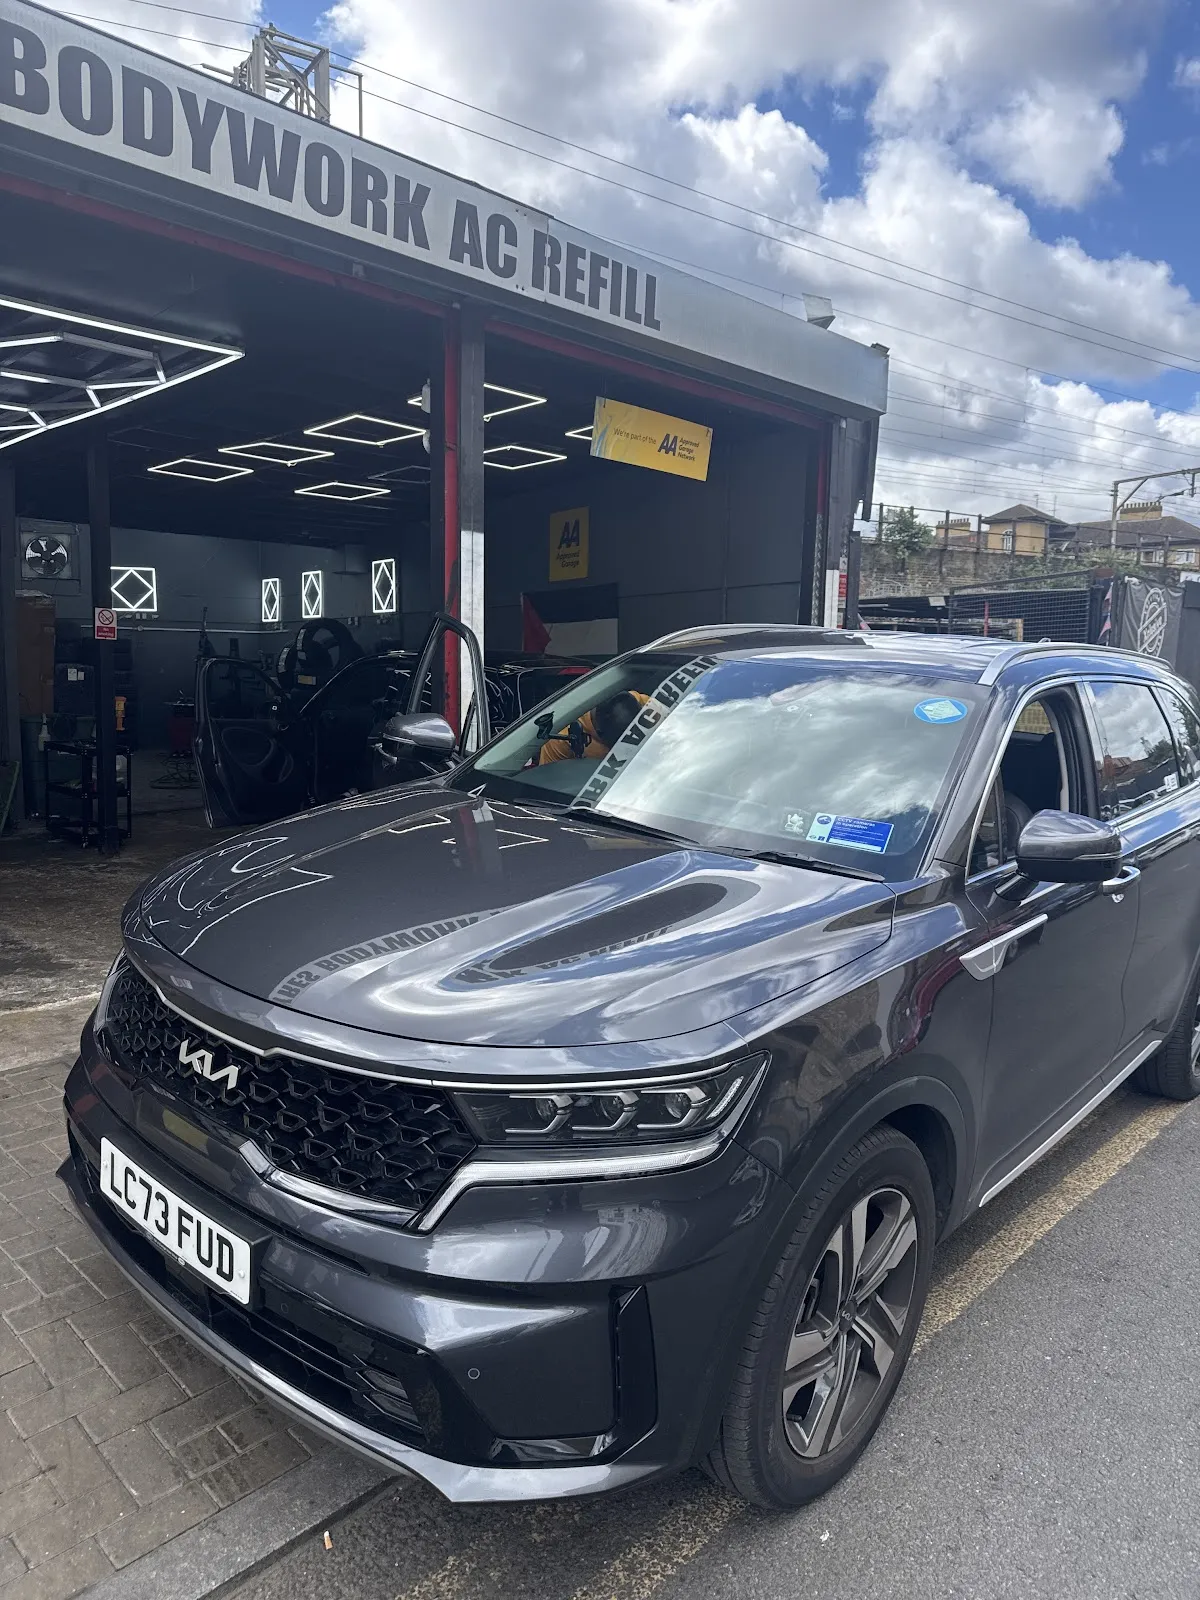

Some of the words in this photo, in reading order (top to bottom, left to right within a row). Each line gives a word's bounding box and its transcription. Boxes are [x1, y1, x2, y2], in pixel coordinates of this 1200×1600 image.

[0, 18, 430, 250] BODYWORK
[449, 200, 518, 279] AC
[532, 229, 661, 331] REFILL
[614, 428, 630, 439] We're
[631, 433, 641, 441] part
[648, 436, 657, 444] the
[657, 433, 678, 456] AA
[679, 437, 700, 448] Approved
[677, 451, 696, 462] Network
[678, 445, 694, 454] Garage
[557, 519, 580, 550] AA
[108, 1151, 170, 1237] LC73
[177, 1204, 235, 1283] FUD
